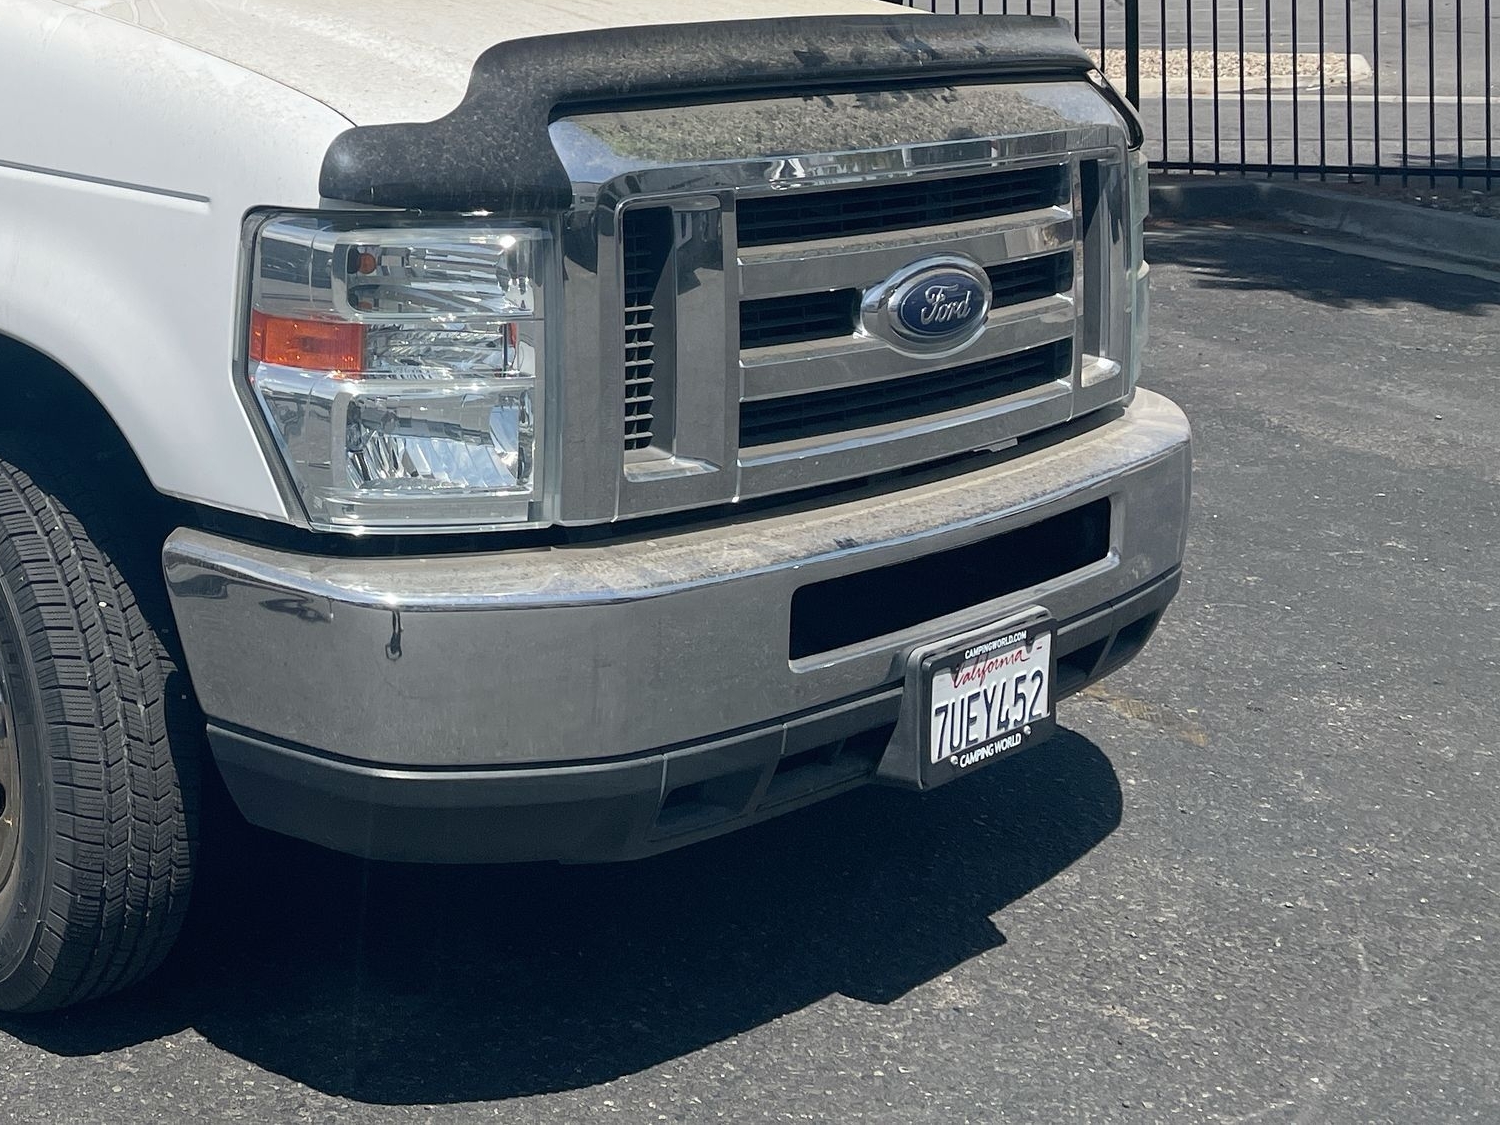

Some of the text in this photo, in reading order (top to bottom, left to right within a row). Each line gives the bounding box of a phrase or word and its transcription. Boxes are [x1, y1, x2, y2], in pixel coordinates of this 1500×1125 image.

[920, 283, 972, 326] Ford
[964, 630, 1027, 660] CAMPINGWORLD.COM
[953, 648, 1031, 689] California
[934, 669, 1045, 760] 7UEY452
[959, 732, 1022, 768] CAMPING WORLD
